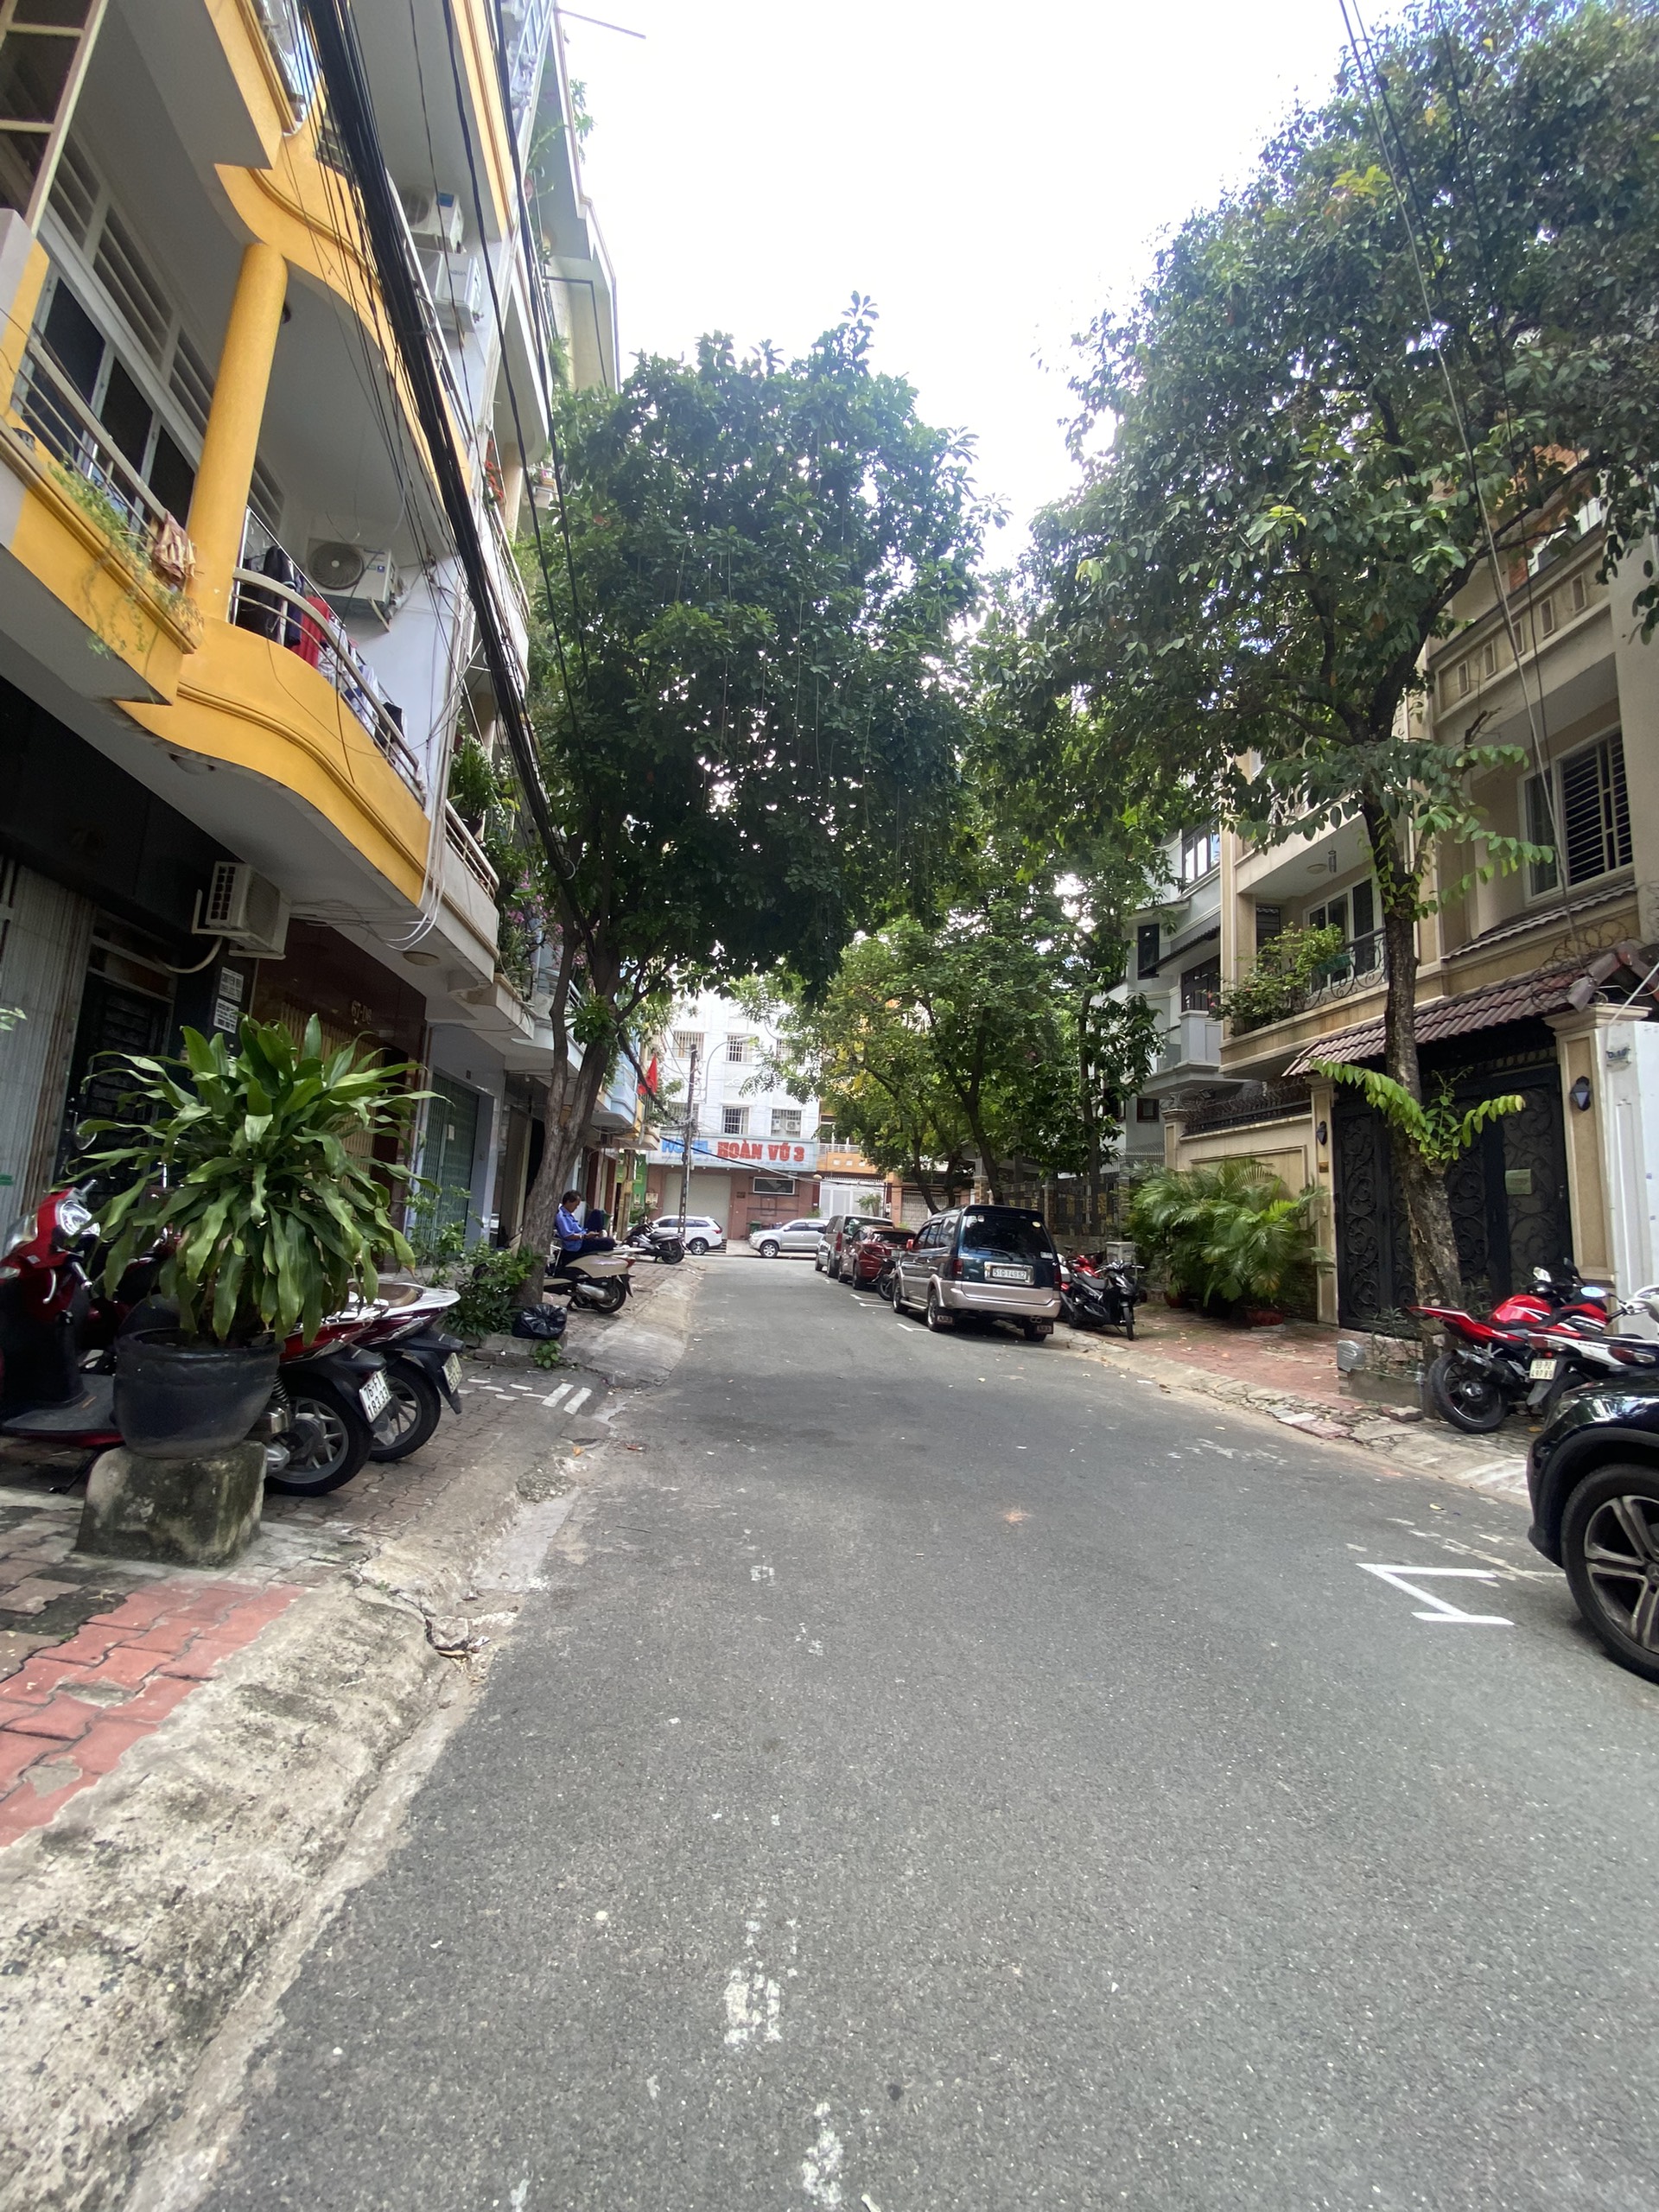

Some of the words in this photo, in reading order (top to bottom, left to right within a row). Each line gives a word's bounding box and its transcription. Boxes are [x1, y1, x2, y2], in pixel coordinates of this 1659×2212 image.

[662, 1139, 712, 1155] HOEL
[717, 1139, 763, 1160] HOÀN
[793, 1146, 804, 1162] 3
